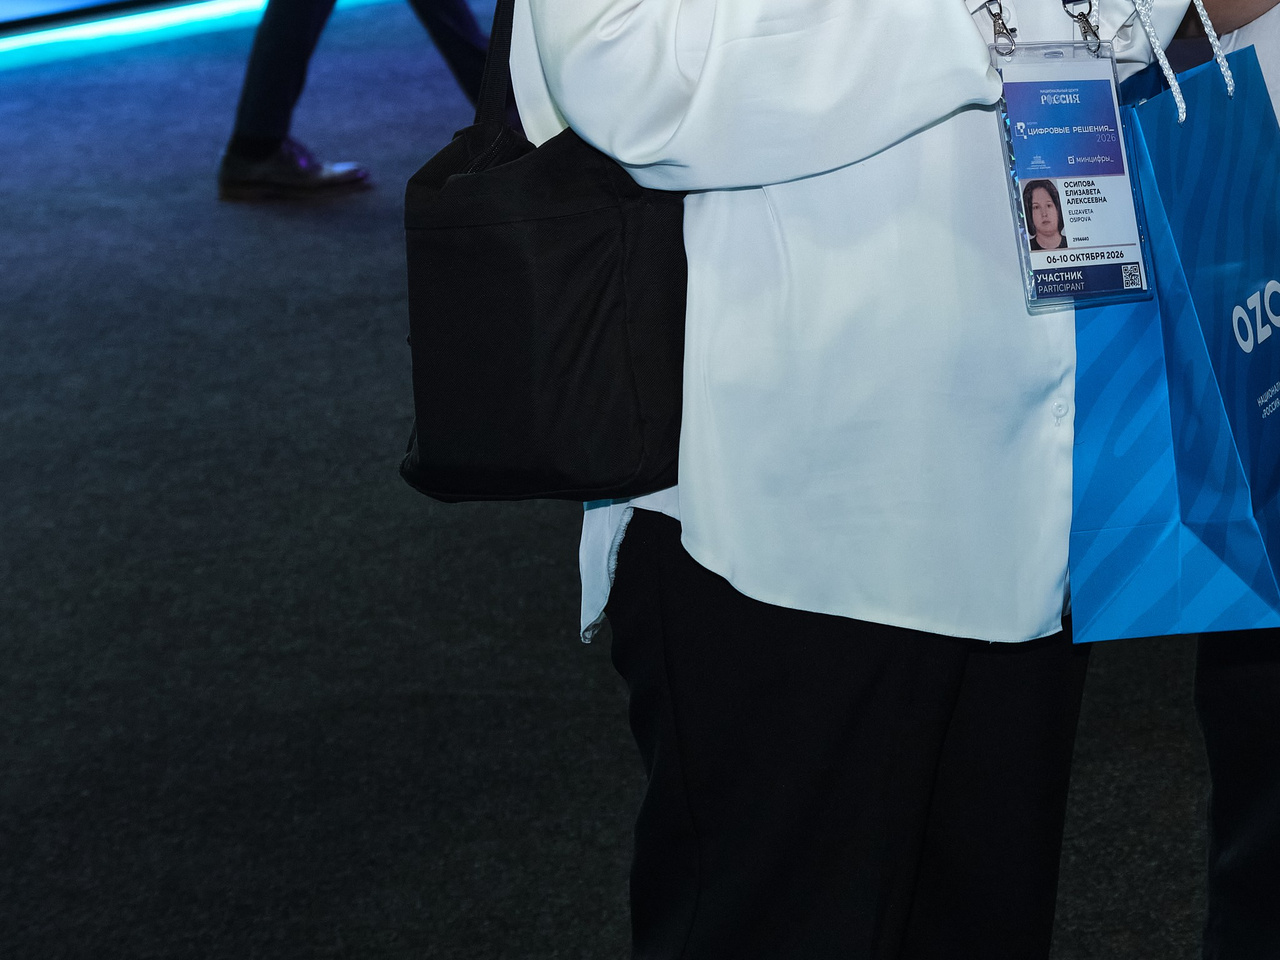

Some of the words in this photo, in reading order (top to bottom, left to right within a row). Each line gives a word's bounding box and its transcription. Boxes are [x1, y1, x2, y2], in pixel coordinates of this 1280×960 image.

[1041, 93, 1081, 105] РОССИЯ
[1027, 126, 1071, 135] ЦИФРОВЫЕ
[1096, 133, 1117, 143] 2026
[1063, 180, 1096, 188] ОСИПОВА
[1065, 188, 1101, 196] ЕЛИЗАВЕТА
[1066, 196, 1108, 205] АЛЕКСЕЕВНА
[1046, 255, 1068, 264] 06-10
[1069, 252, 1106, 262] ОКТЯБРЯ
[1106, 250, 1125, 259] 2026
[1036, 271, 1083, 283] УЧАСТНИК
[1038, 282, 1085, 293] PARTICIPANT
